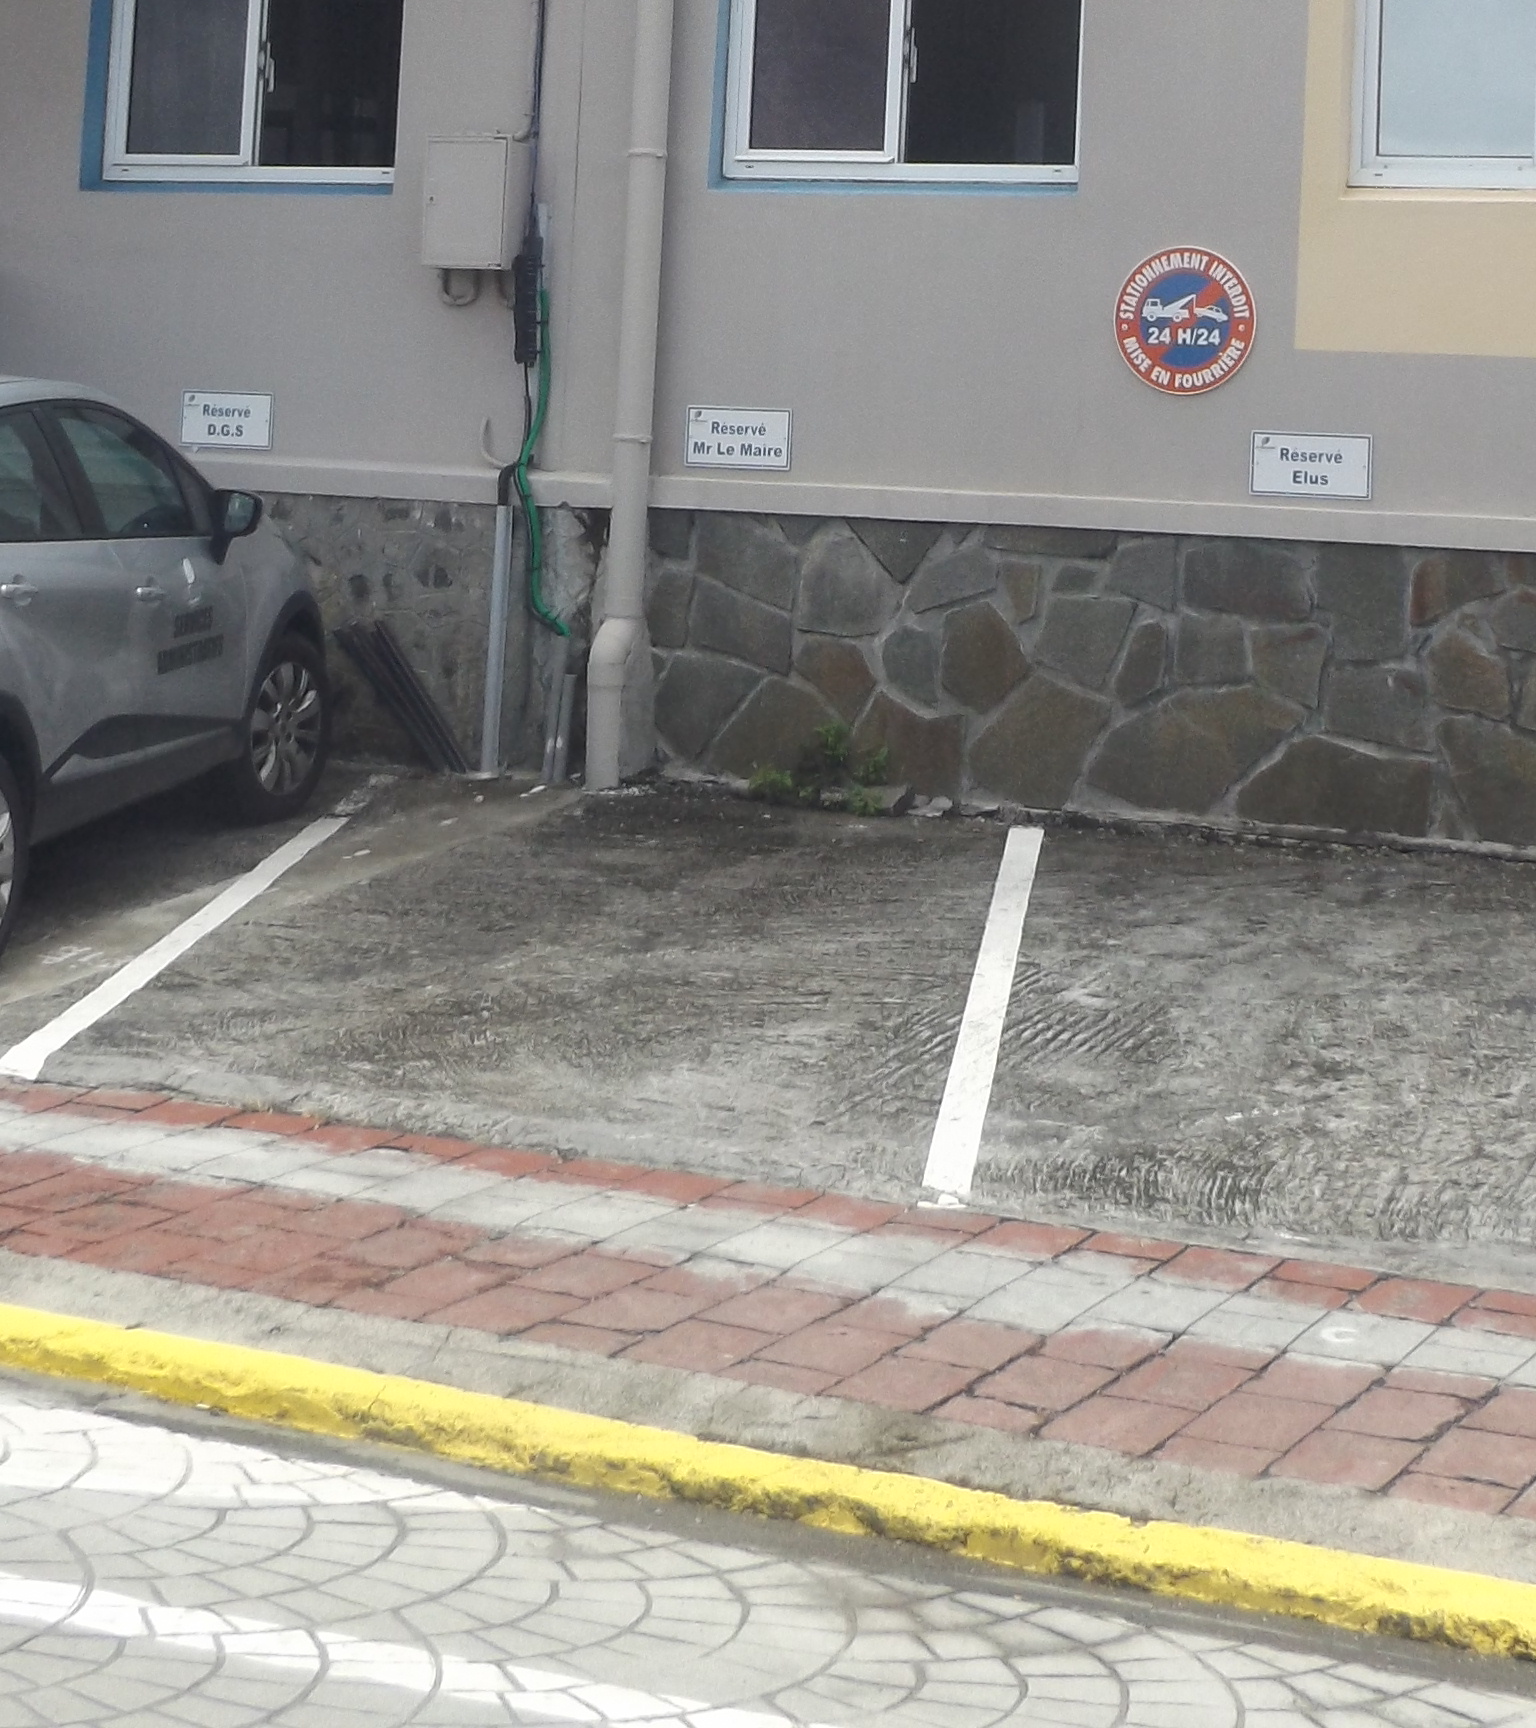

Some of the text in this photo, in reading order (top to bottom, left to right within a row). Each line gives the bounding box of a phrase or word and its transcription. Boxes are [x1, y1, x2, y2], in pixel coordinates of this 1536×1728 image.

[1119, 252, 1250, 319] STATIONNEMENT INTERDIT
[1147, 327, 1221, 346] 24 H/24
[1123, 337, 1152, 372] MISE
[1150, 366, 1170, 385] EN
[202, 403, 252, 418] Réservé
[207, 423, 244, 437] D.G.S
[711, 421, 766, 436] Réservé
[693, 441, 782, 457] Mr Le Maire
[1279, 447, 1343, 464] Réservé
[1292, 470, 1329, 485] Elus
